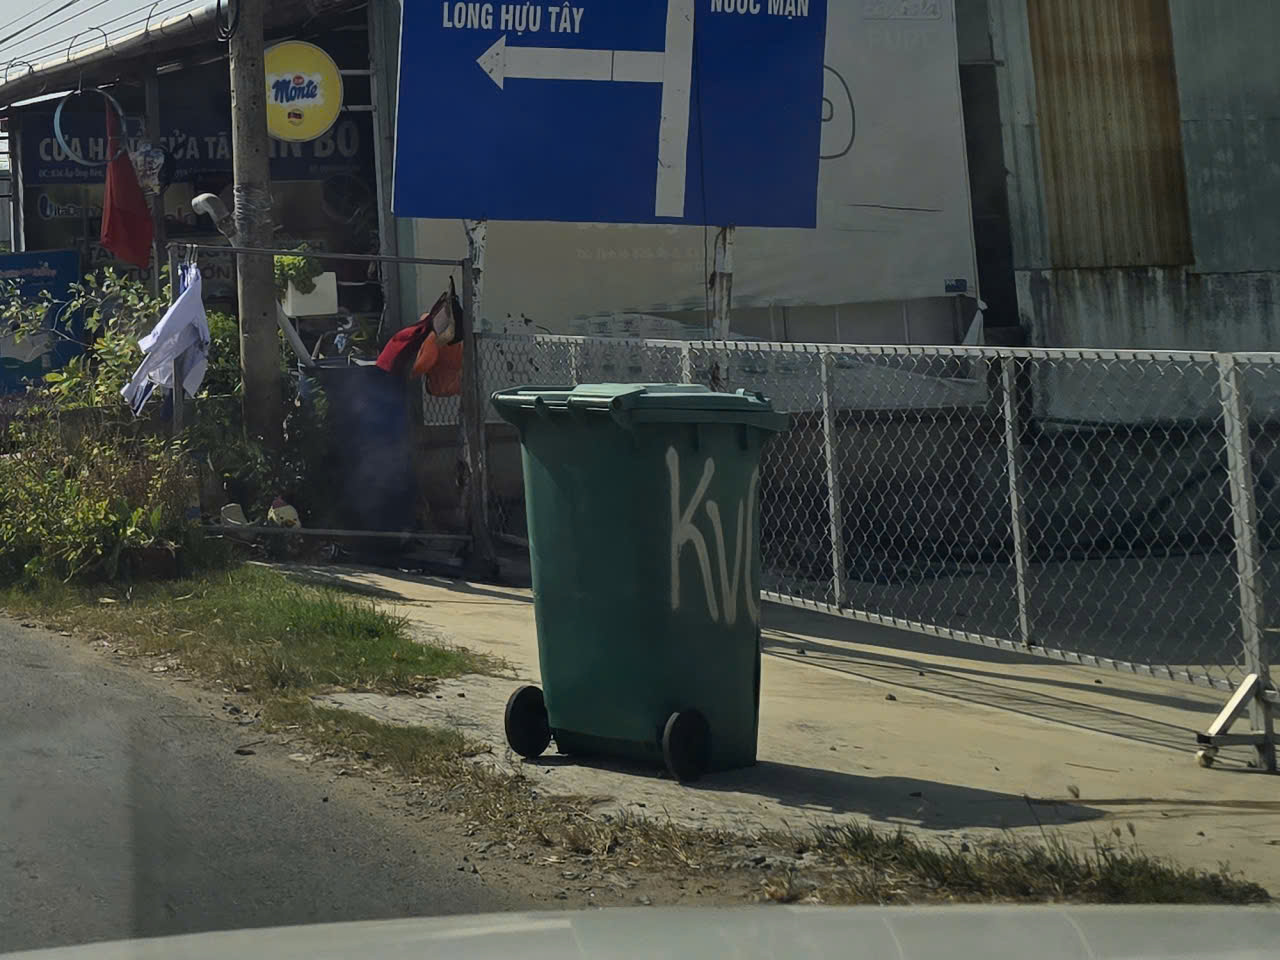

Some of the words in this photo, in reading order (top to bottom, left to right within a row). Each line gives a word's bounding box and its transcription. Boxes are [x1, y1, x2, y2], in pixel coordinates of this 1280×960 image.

[442, 1, 494, 30] LONG
[500, 3, 542, 36] HỰU
[548, 1, 585, 34] TÂY
[272, 78, 318, 103] Monte
